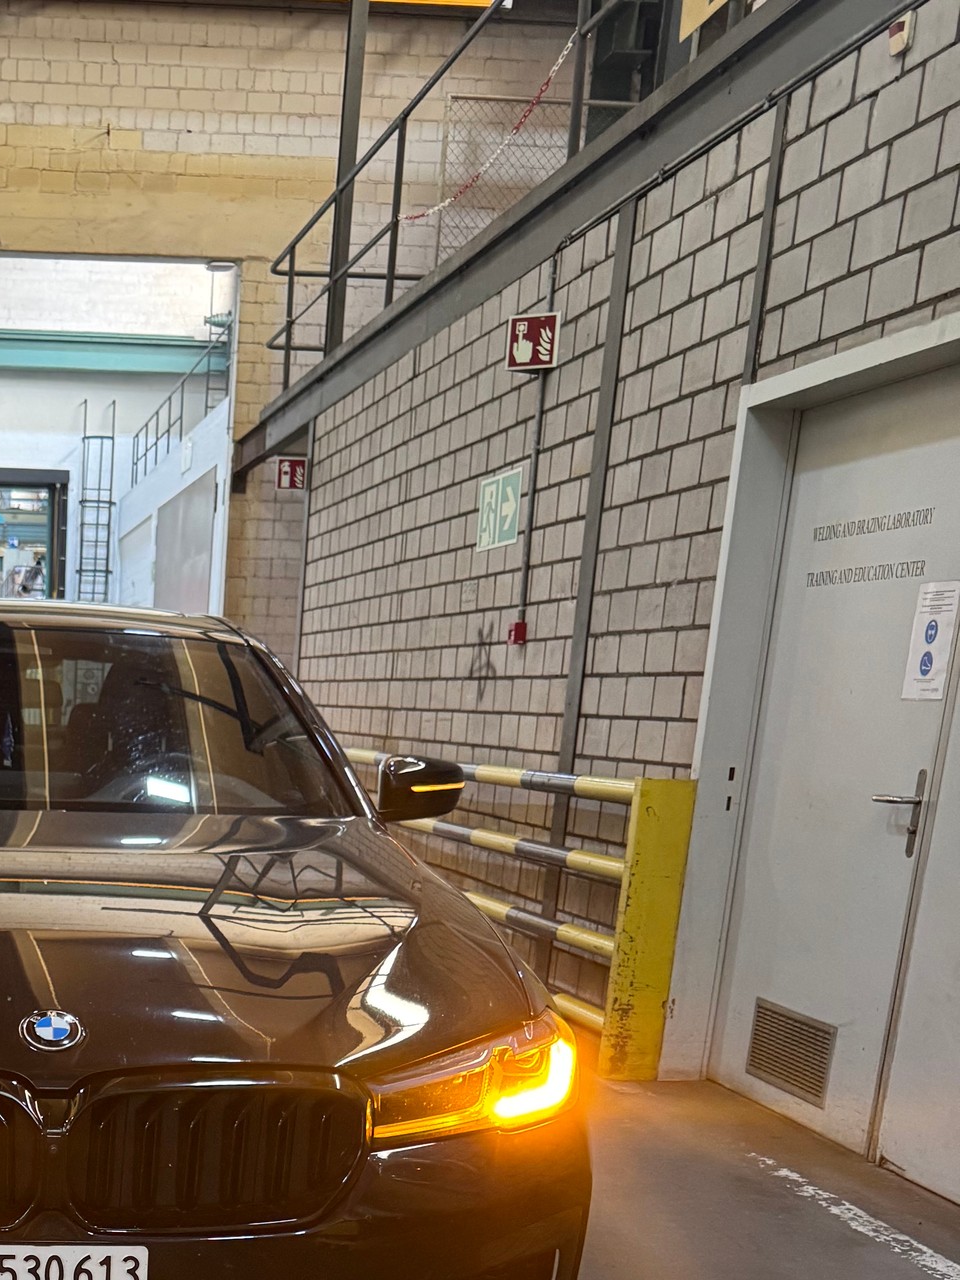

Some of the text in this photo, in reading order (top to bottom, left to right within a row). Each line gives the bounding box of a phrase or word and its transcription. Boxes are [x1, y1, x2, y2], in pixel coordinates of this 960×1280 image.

[813, 507, 936, 542] WELDING AND BRAZING LABORATORY
[806, 560, 926, 588] TRAINING AND EDUCATION CENTER
